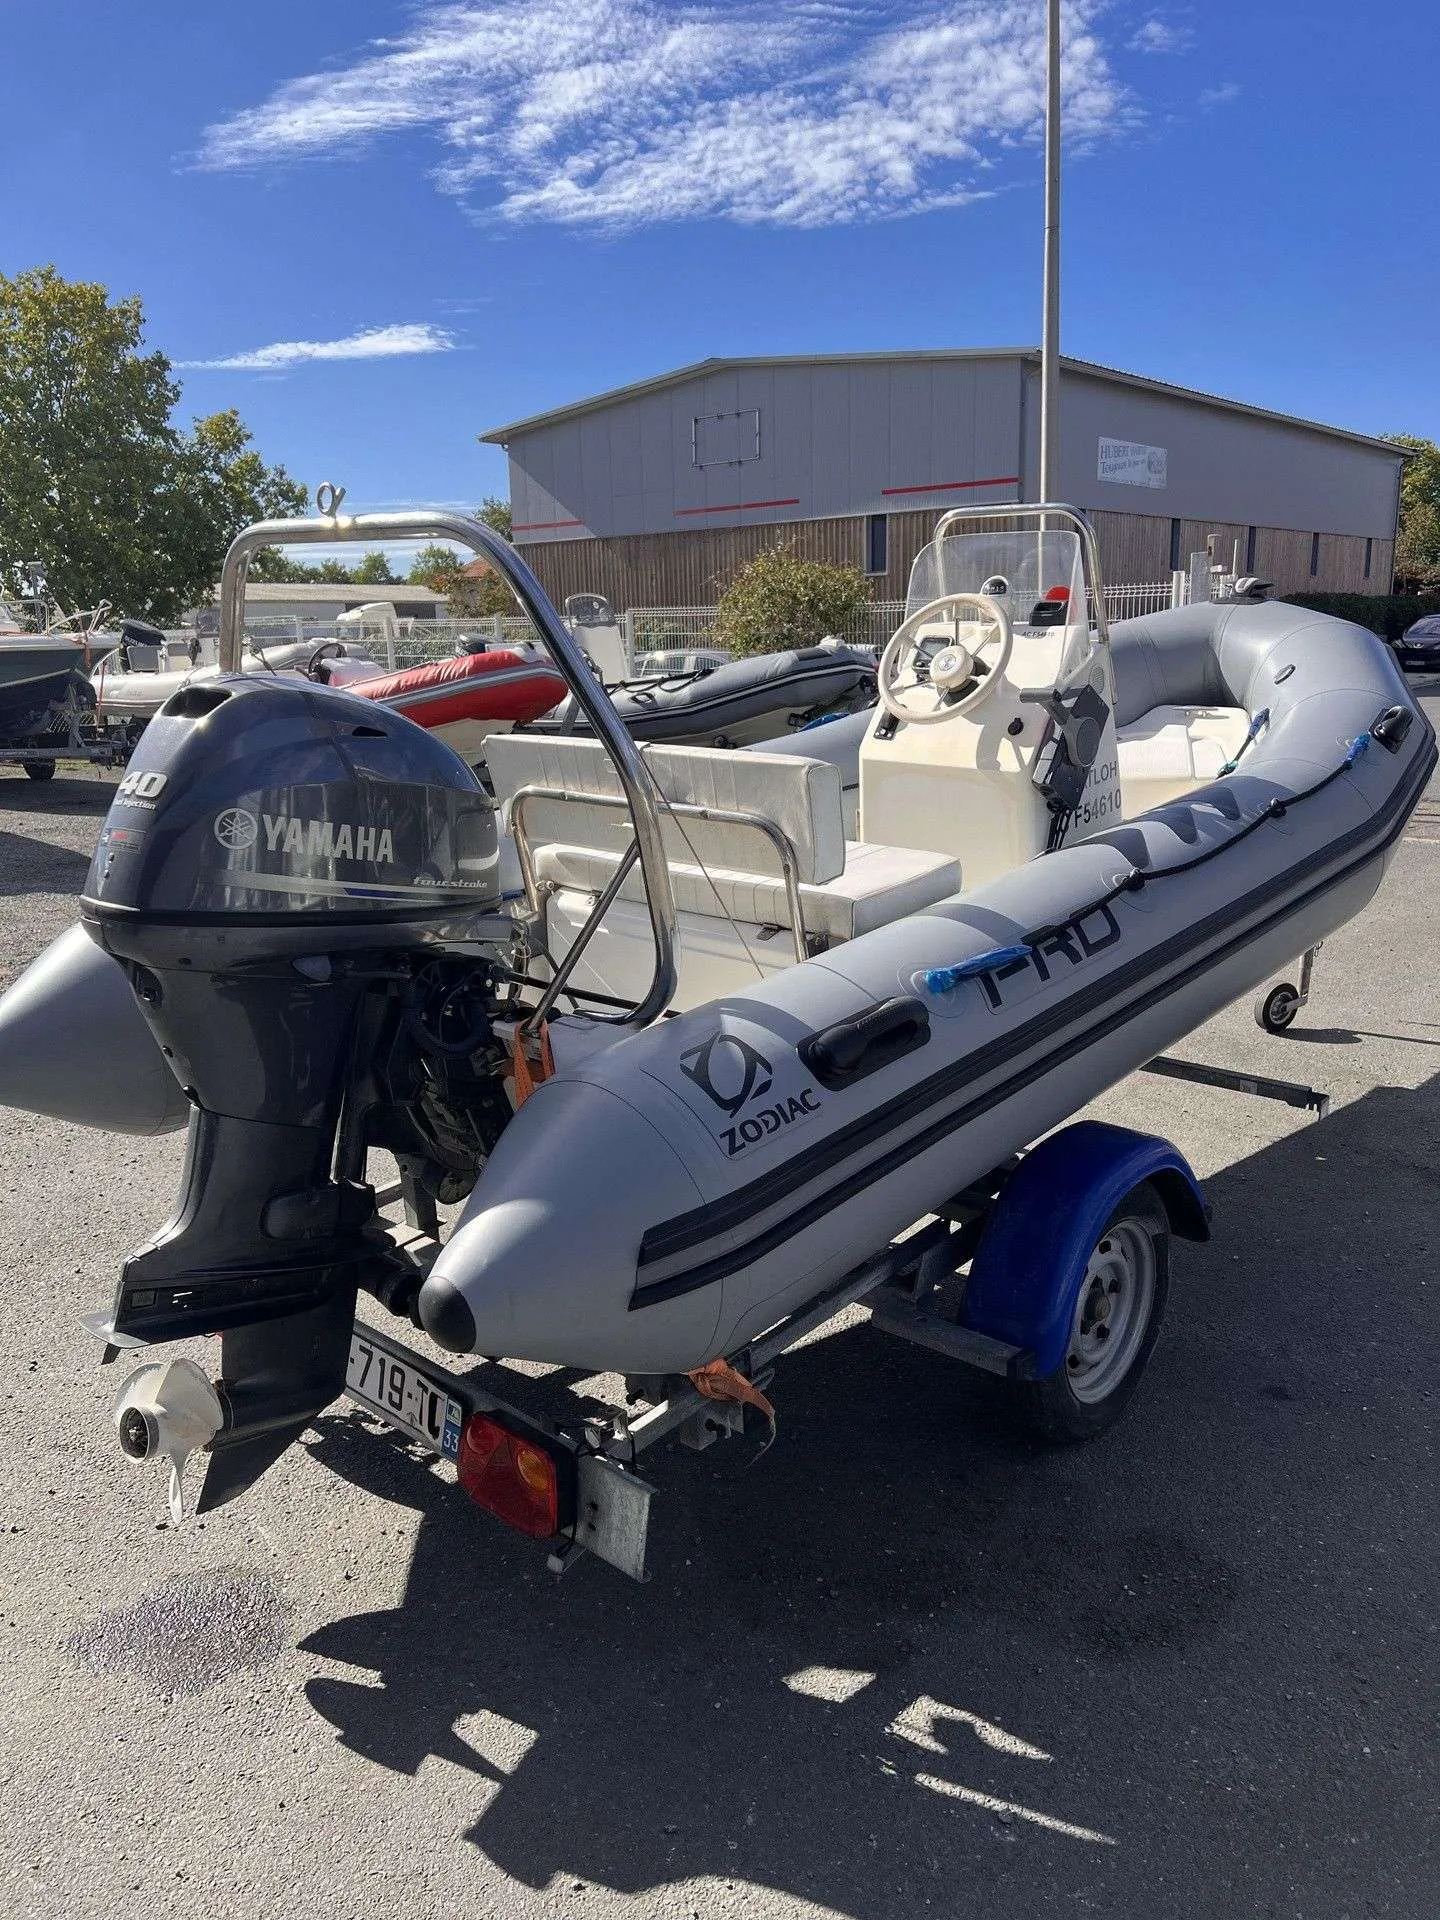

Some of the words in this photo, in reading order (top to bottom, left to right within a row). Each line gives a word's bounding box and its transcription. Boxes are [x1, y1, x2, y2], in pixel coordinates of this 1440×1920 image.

[119, 770, 168, 798] 40
[262, 814, 394, 864] YAMAHA
[718, 1087, 822, 1156] ZODIAC
[443, 1428, 459, 1453] 33
